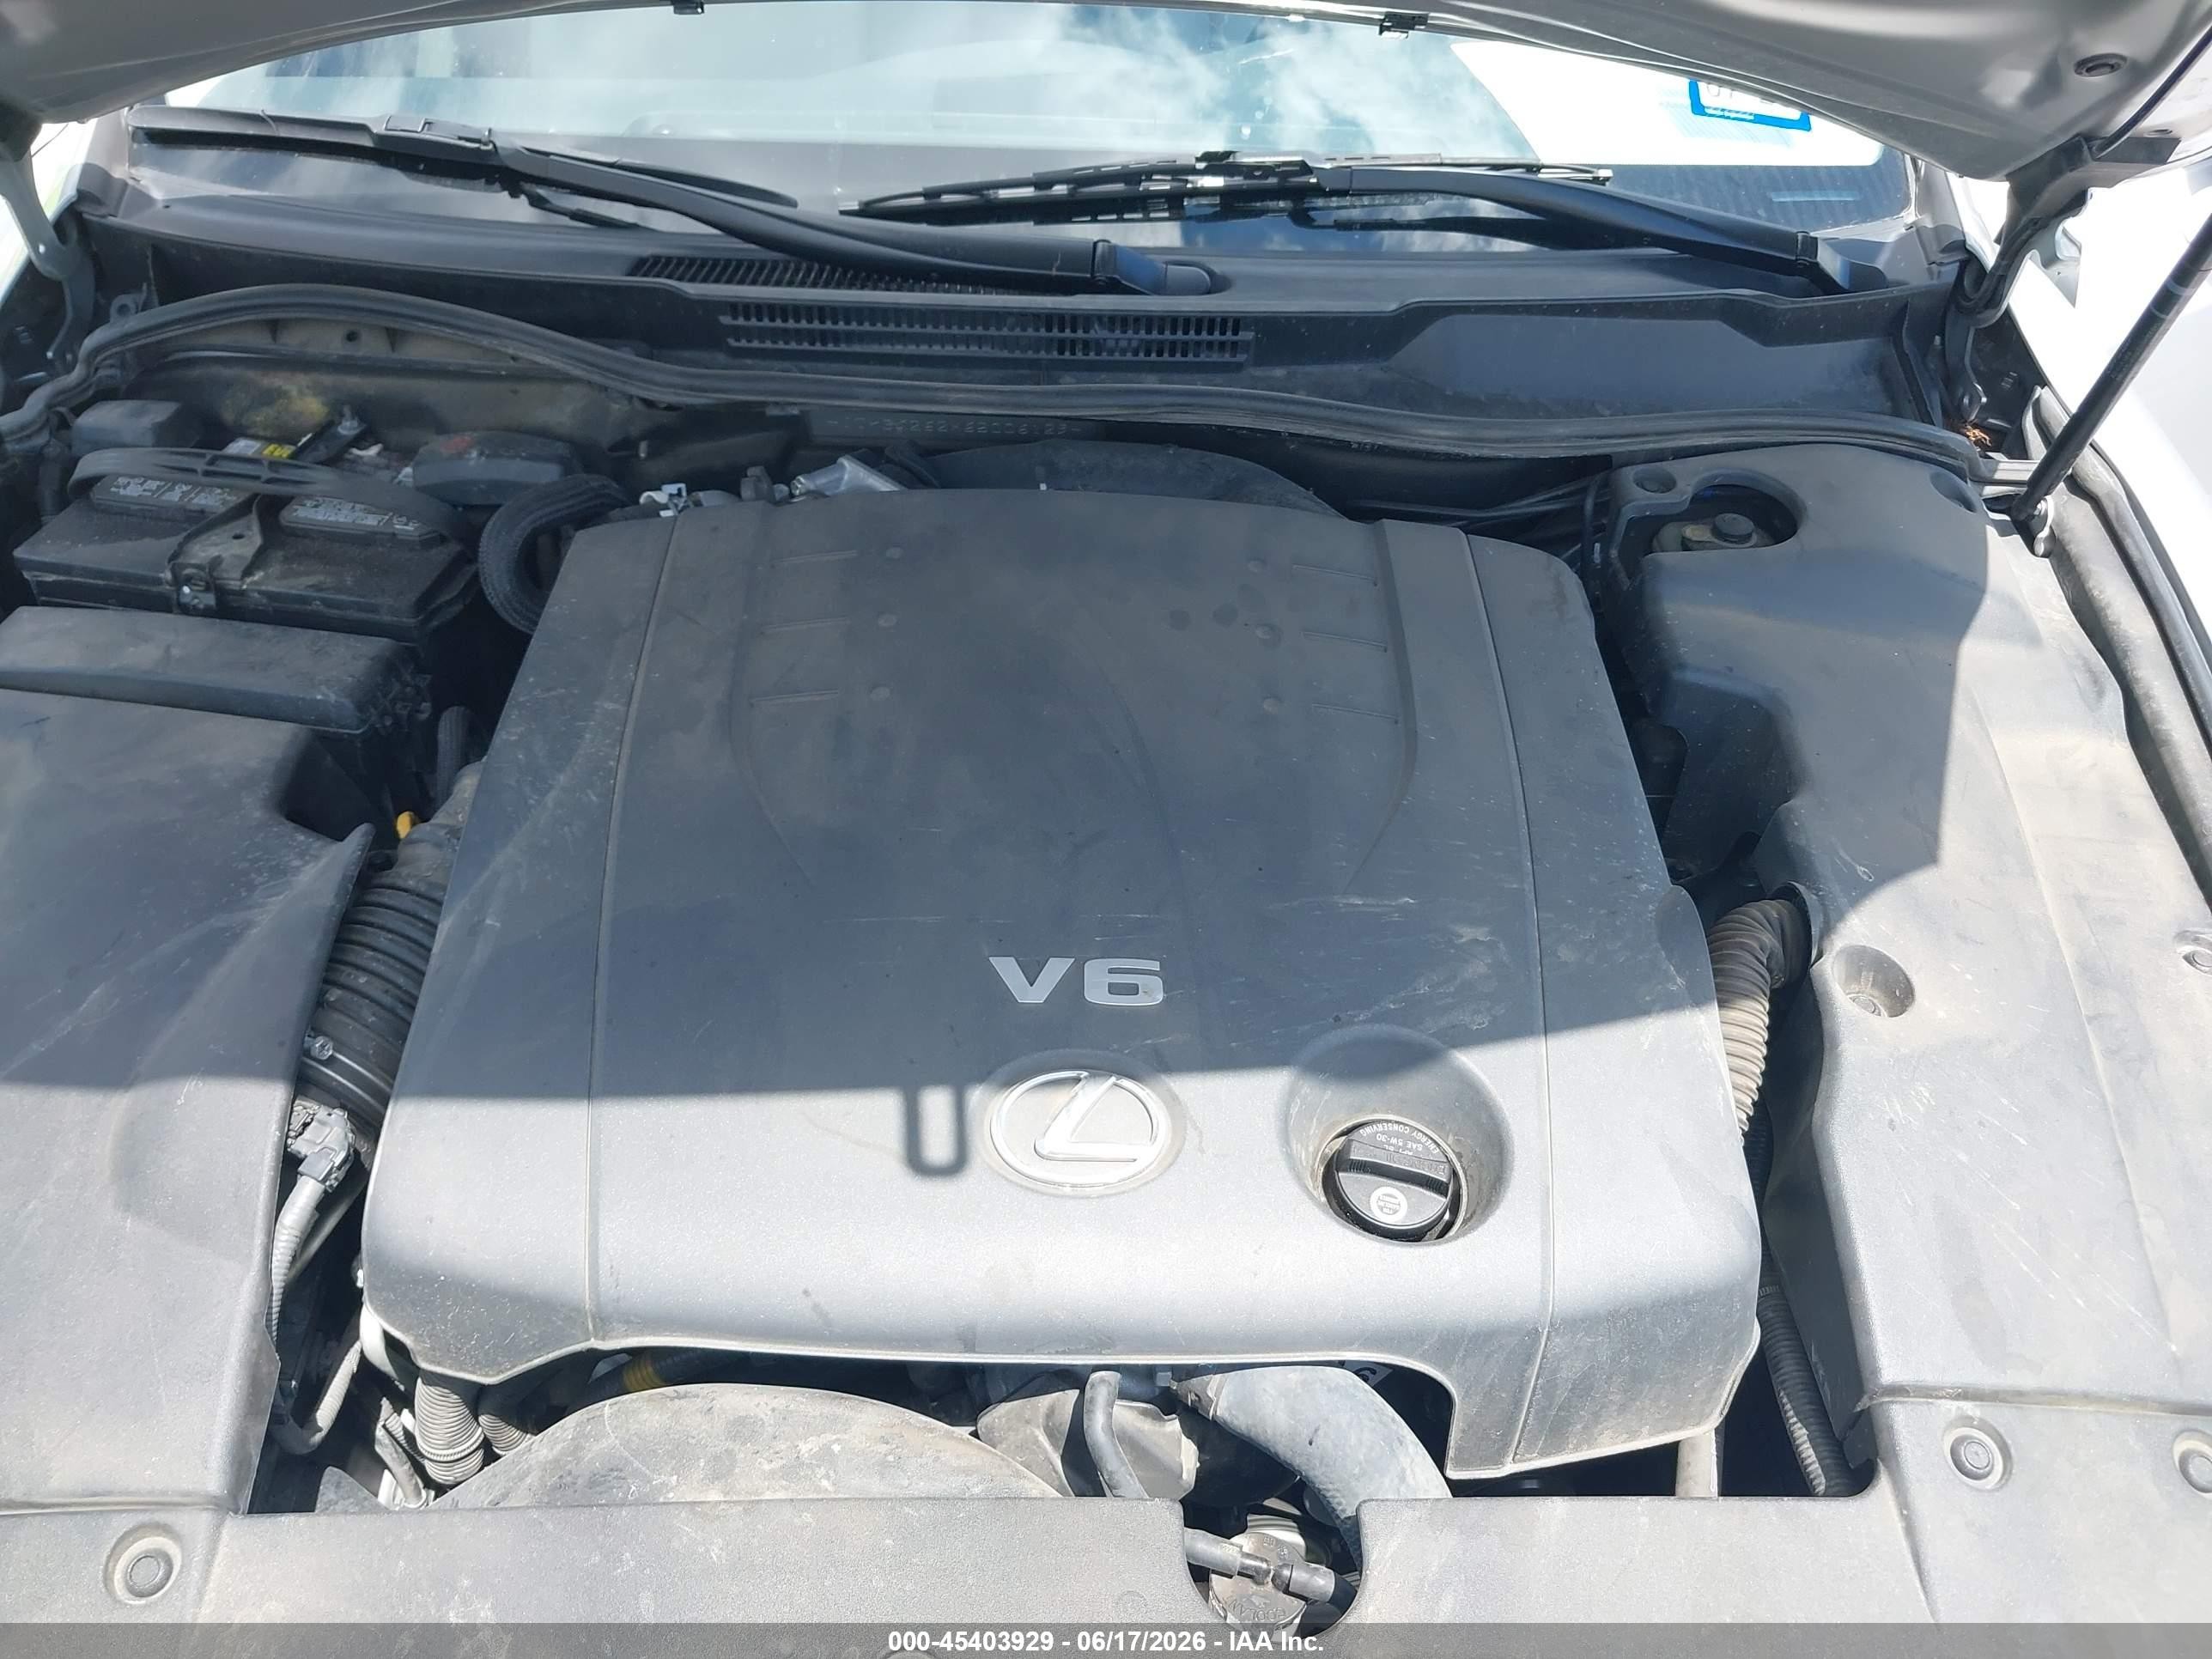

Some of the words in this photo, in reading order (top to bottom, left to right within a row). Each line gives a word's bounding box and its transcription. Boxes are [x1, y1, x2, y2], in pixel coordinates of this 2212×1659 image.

[988, 957, 1163, 1006] V6
[1359, 1122, 1410, 1137] CONSERVING
[1376, 1133, 1403, 1147] 5W-30
[1407, 1140, 1423, 1152] SAE
[1411, 1130, 1440, 1154] ENERGY
